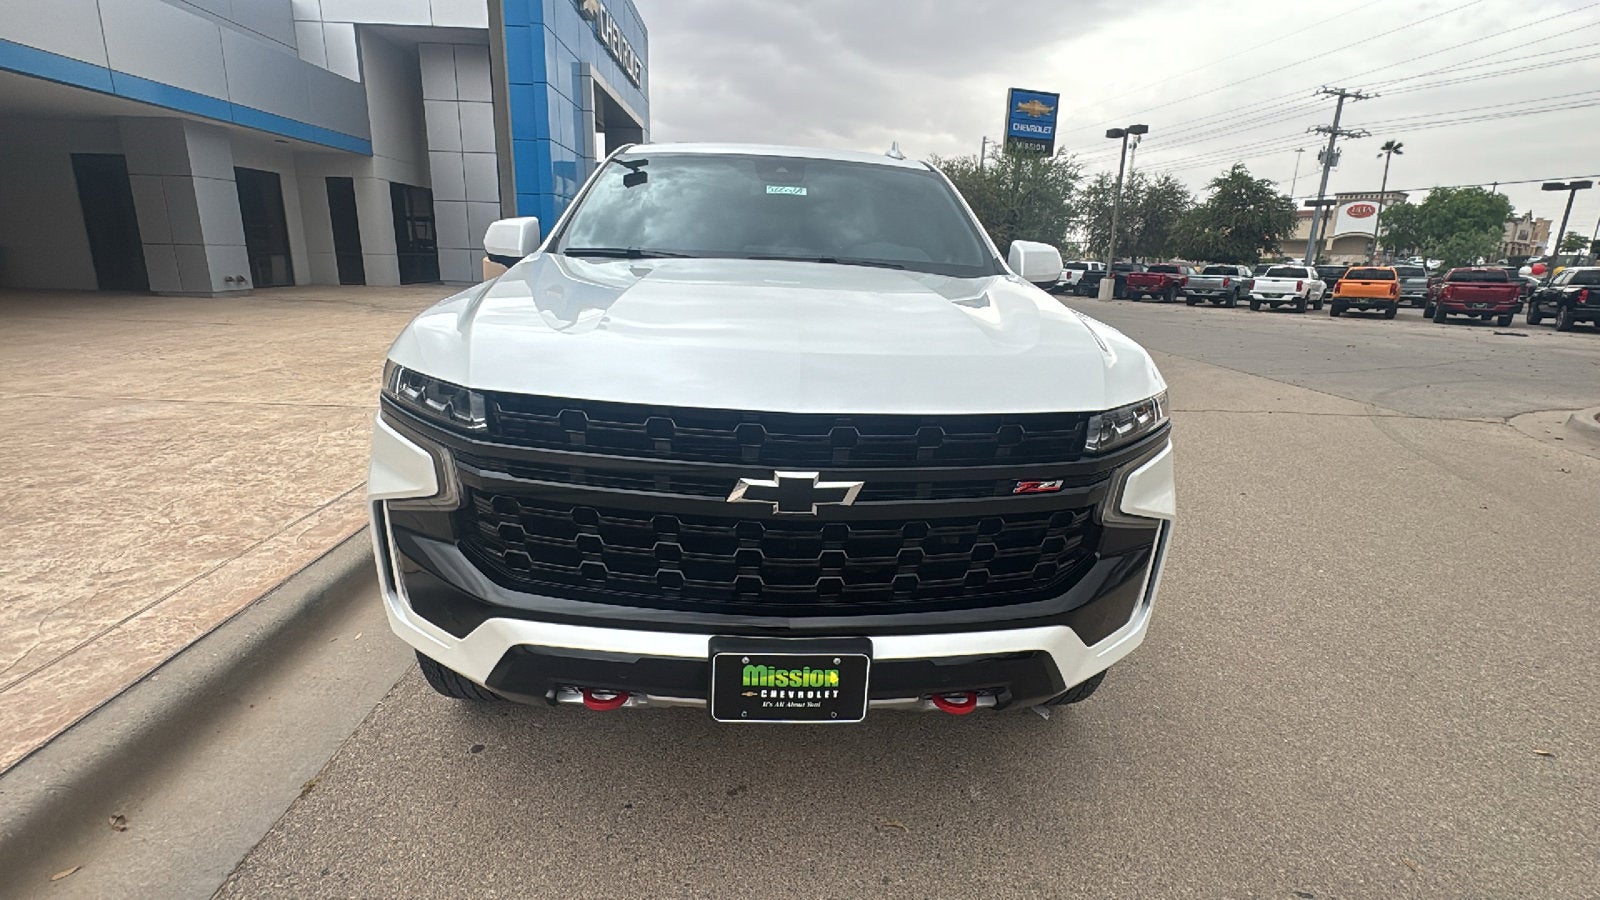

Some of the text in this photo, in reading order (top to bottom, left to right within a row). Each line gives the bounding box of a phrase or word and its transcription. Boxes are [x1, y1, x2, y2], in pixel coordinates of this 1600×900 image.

[600, 2, 642, 87] CHEVROLET
[1013, 122, 1053, 134] CHEVROLET
[1012, 480, 1064, 493] Z71
[742, 665, 839, 687] Mission
[760, 689, 839, 699] CHEVROLET
